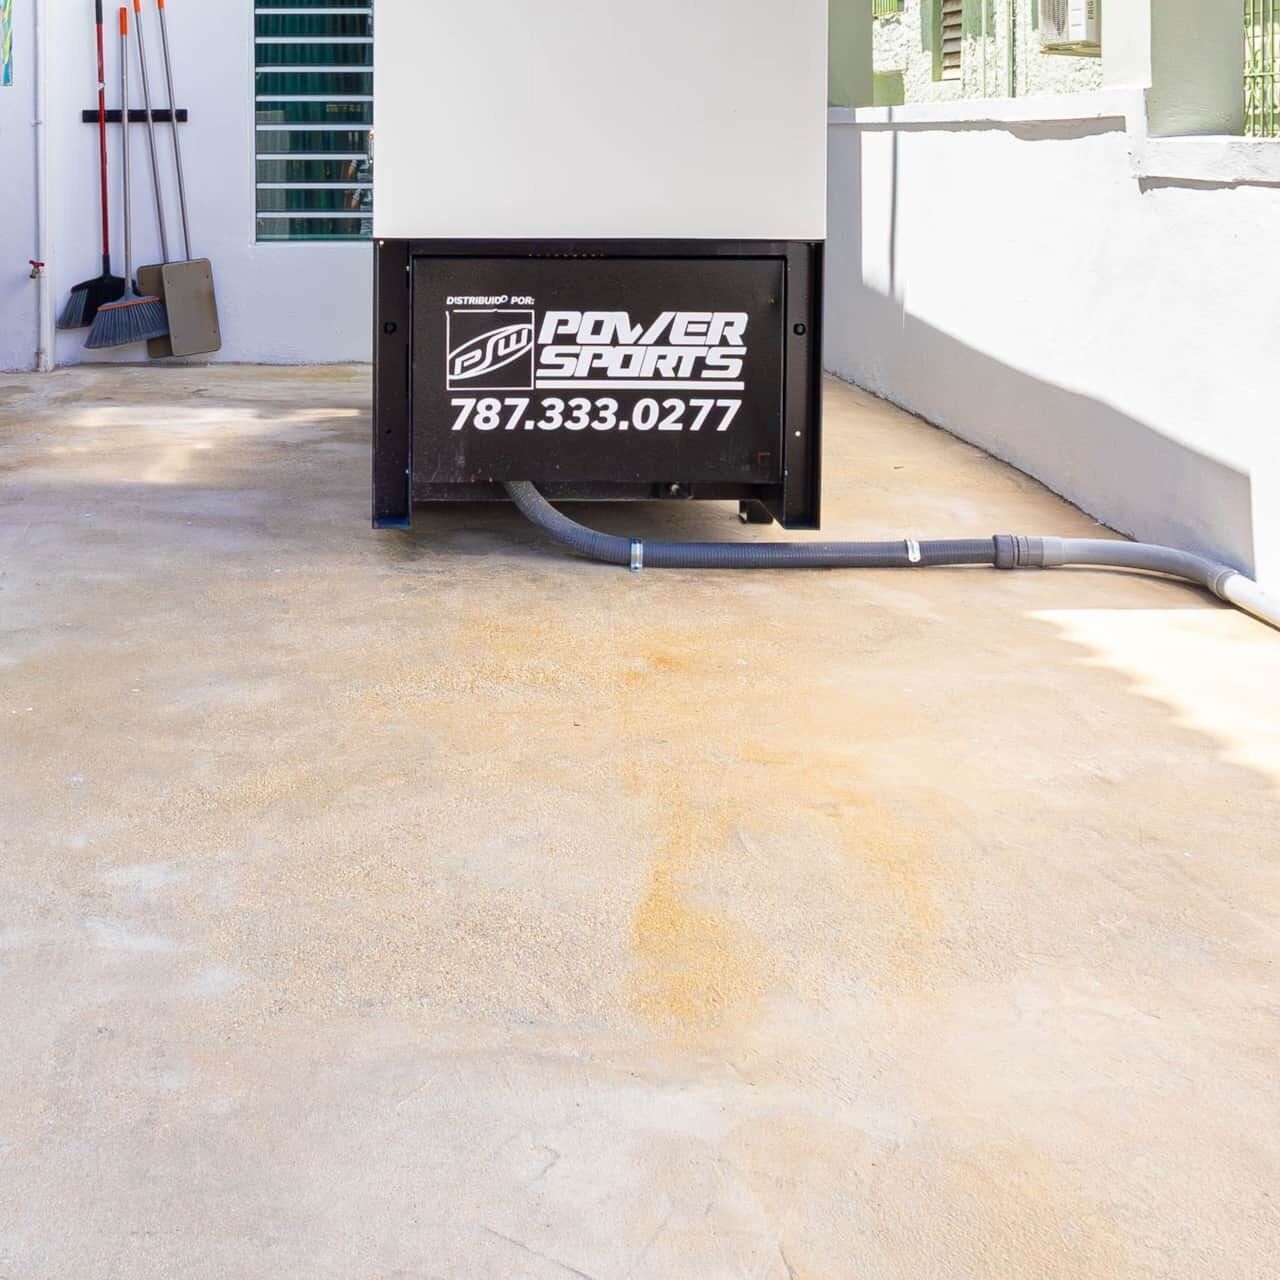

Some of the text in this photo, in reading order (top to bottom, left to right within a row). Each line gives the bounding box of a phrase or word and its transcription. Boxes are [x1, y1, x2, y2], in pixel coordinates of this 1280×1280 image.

[446, 295, 535, 305] DISTRIBUIDO POR:
[537, 311, 749, 345] POWER
[536, 345, 747, 377] SPORTS
[450, 397, 742, 431] 787.333.0277
